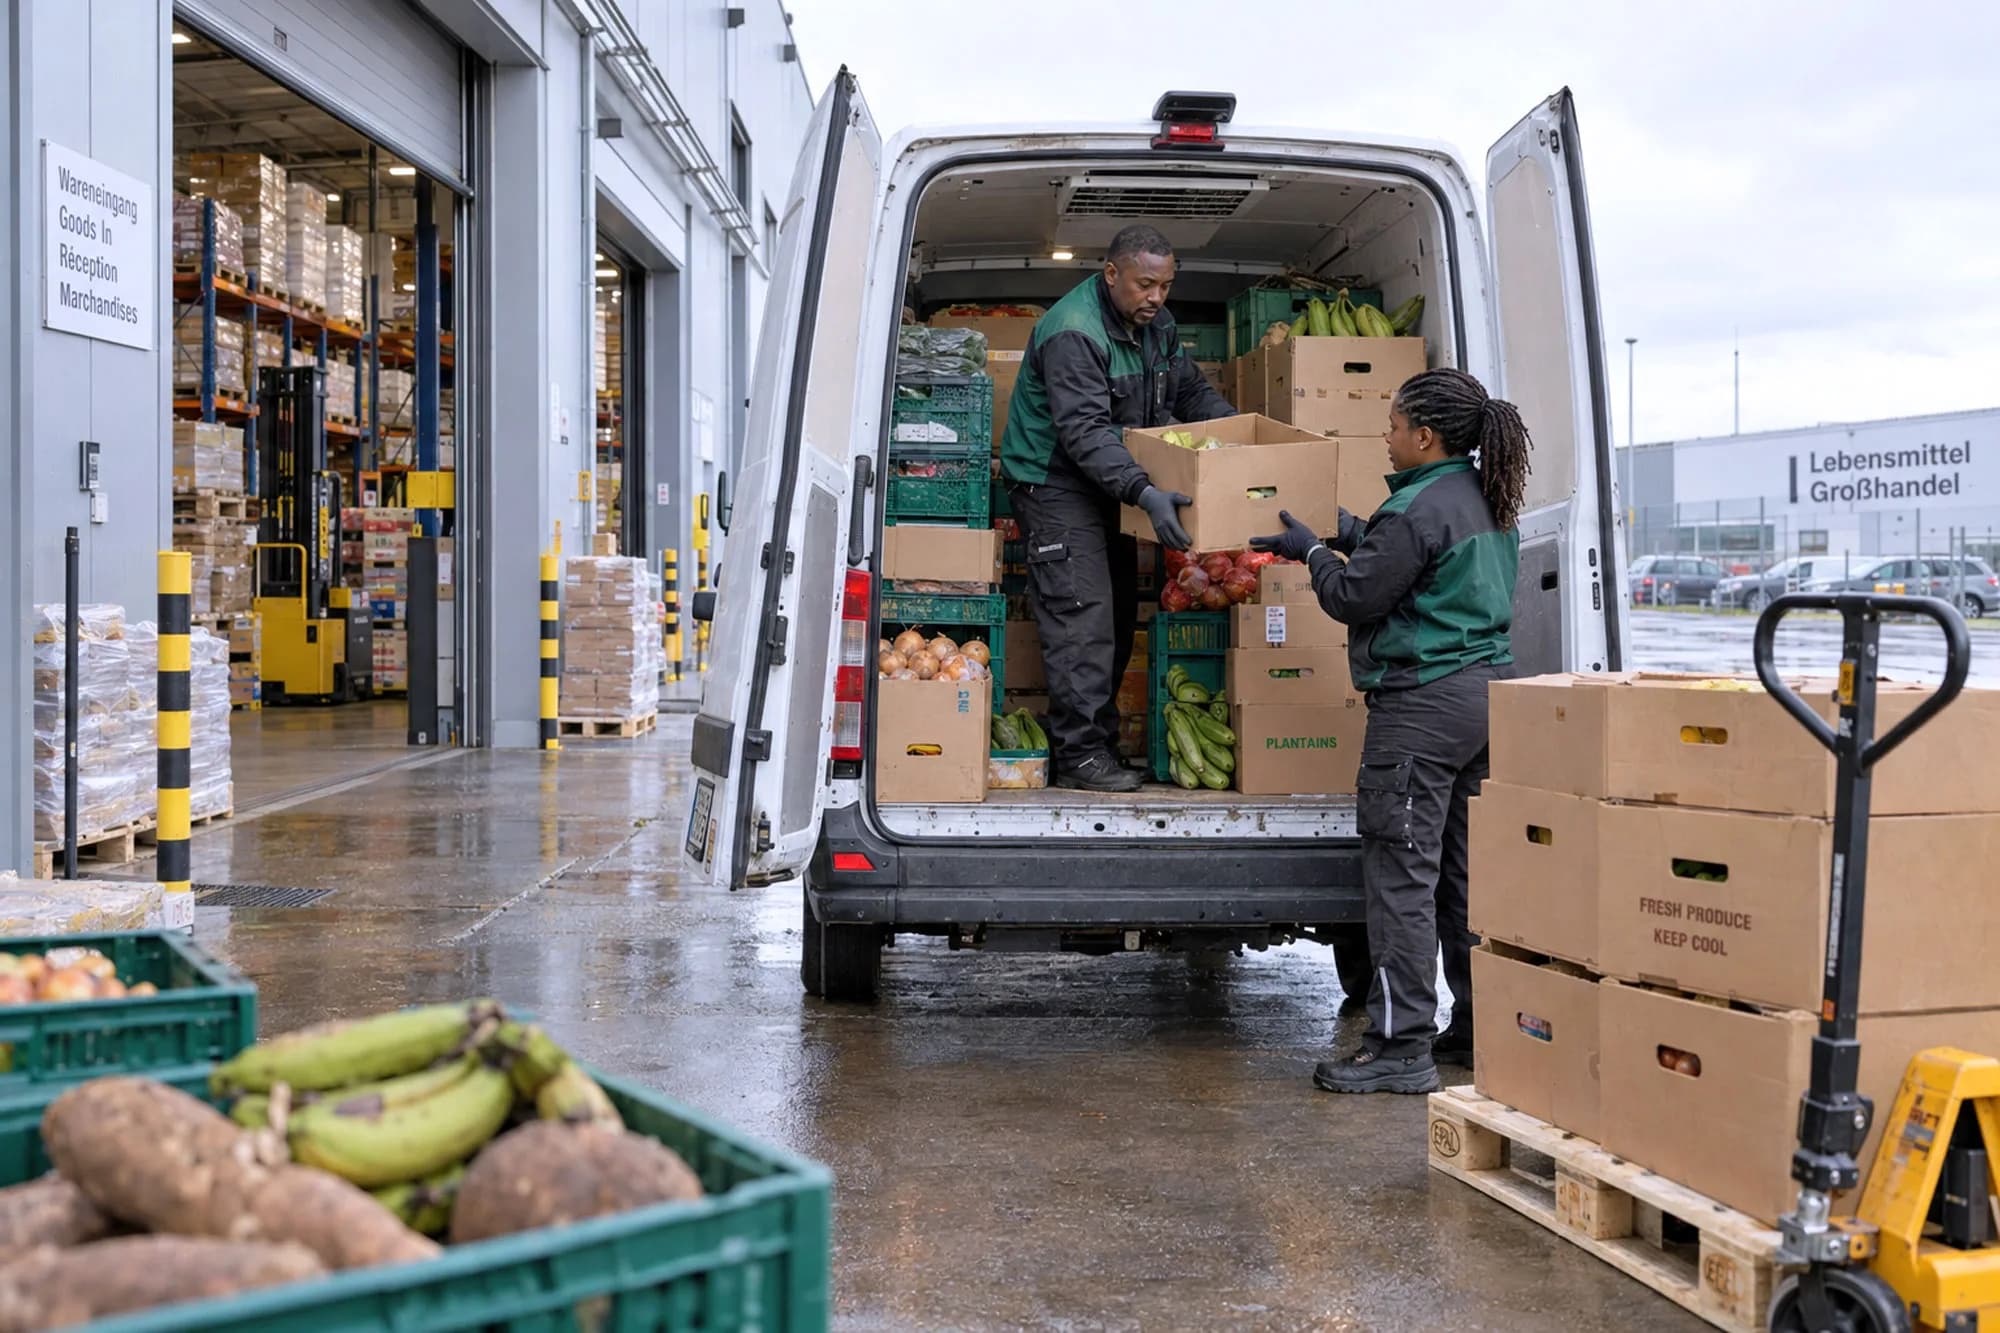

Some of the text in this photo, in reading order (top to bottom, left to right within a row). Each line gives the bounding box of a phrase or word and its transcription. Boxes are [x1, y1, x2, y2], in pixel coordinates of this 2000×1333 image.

[58, 165, 138, 225] Wareneingang
[59, 204, 112, 246] Goods In
[59, 242, 118, 283] Réception
[60, 281, 138, 324] Marchandises
[1810, 440, 1970, 473] Lebensmittel
[1810, 472, 1960, 503] Großhandel
[1266, 736, 1337, 750] PLANTAINS
[1639, 897, 1752, 931] FRESH PRODUCE
[1654, 927, 1728, 956] KEEP COOL
[1434, 1123, 1457, 1153] EPAL
